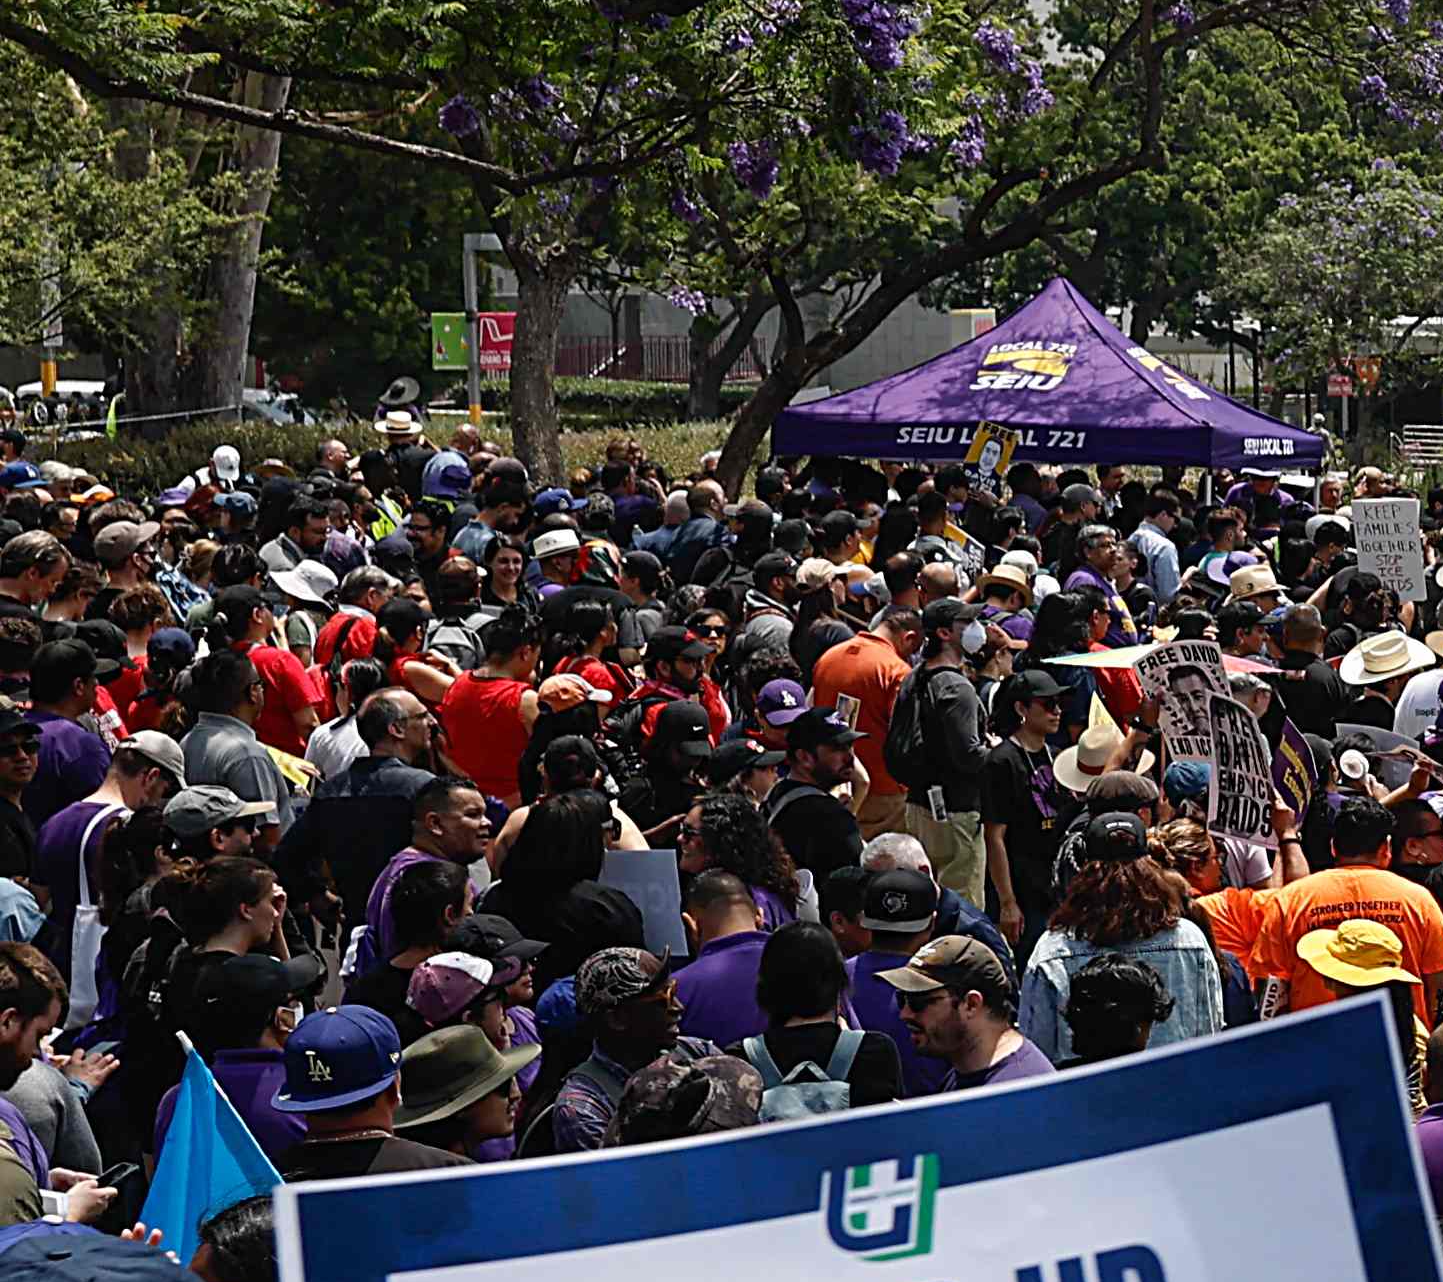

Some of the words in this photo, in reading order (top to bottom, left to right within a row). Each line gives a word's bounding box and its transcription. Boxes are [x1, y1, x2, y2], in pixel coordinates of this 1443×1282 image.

[990, 341, 1045, 354] LOCAL
[1049, 343, 1078, 356] 721
[969, 373, 1063, 390] SEIU
[897, 427, 955, 444] SEIU
[959, 428, 1039, 447] LAL
[1046, 431, 1087, 449] 721
[1362, 504, 1400, 520] KEEP
[1357, 521, 1415, 537] FAMILIES
[1360, 539, 1417, 554] TOGETHER
[1375, 554, 1402, 566] STOP
[1379, 567, 1401, 577] ICE
[1138, 647, 1179, 674] FREE
[1181, 643, 1220, 664] DAVID
[1170, 738, 1193, 756] END
[1218, 771, 1246, 794] END
[1216, 797, 1273, 838] RAIDS
[1311, 903, 1354, 916] STRONGER
[1356, 901, 1401, 911] TOGETHER
